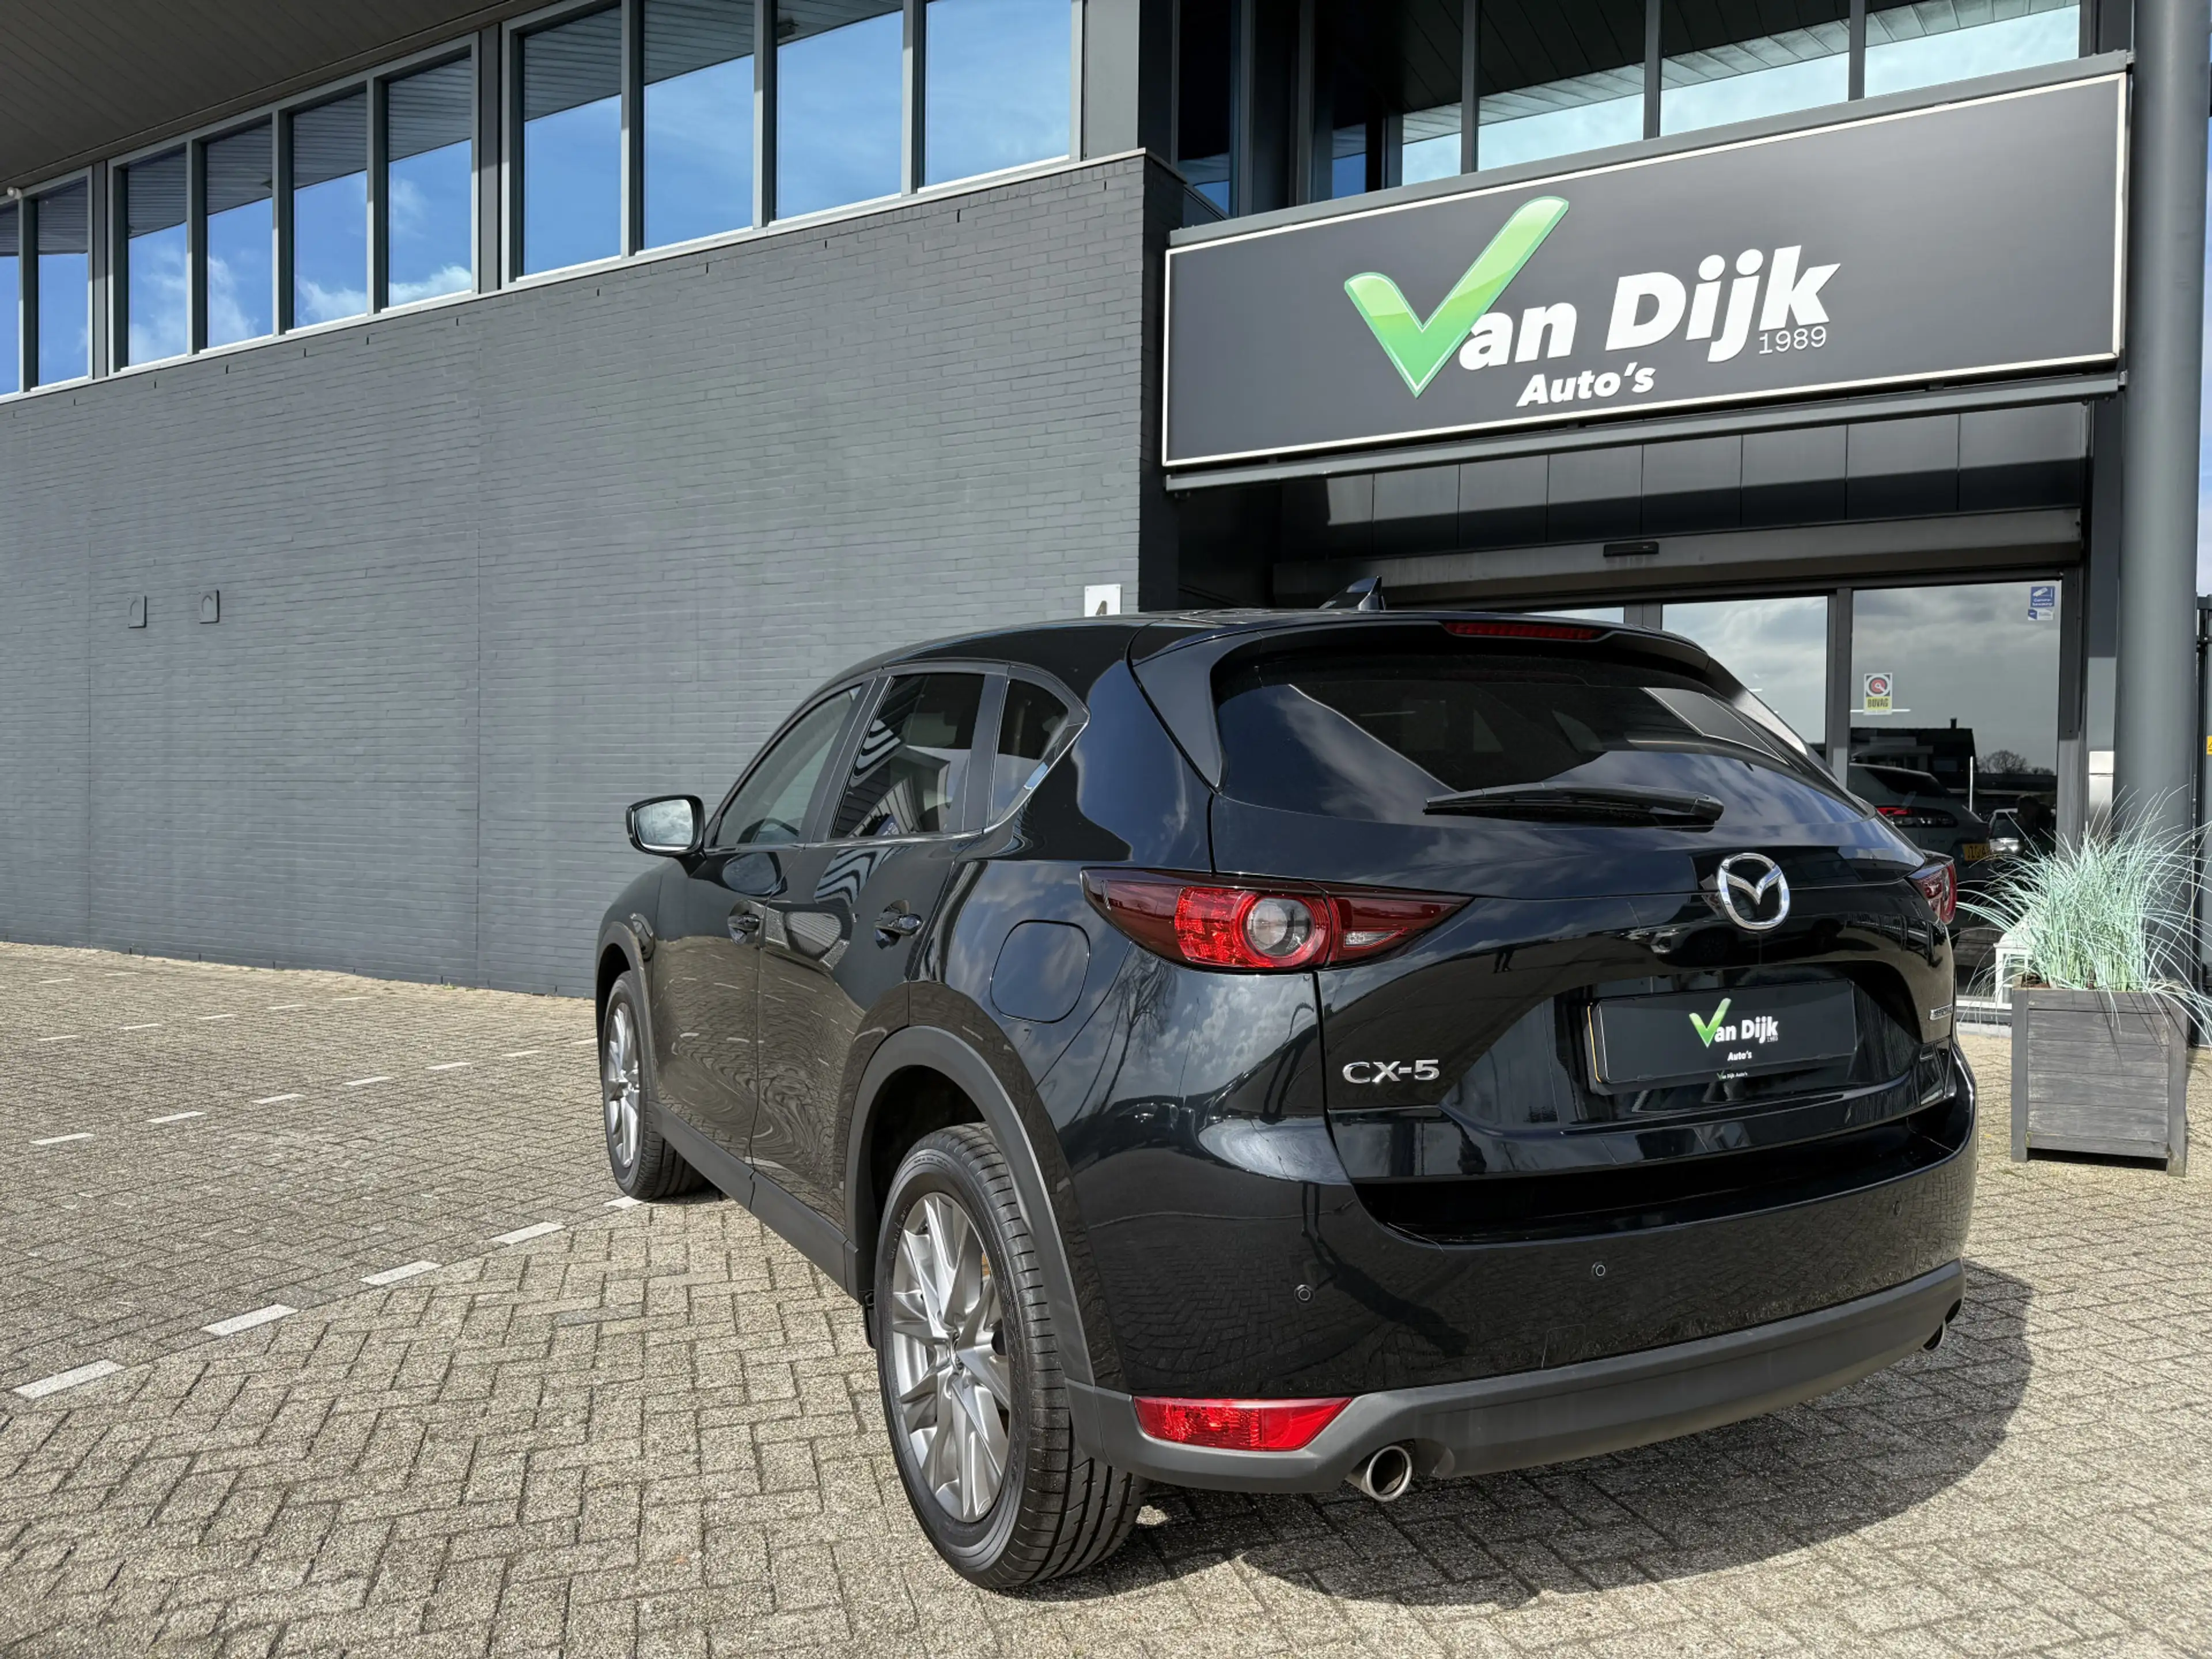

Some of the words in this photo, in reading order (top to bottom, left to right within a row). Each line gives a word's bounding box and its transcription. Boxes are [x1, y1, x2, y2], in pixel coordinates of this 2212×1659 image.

[1343, 195, 1577, 399] Van
[1605, 244, 1841, 363] Dijk
[1758, 325, 1827, 355] 1989
[1516, 362, 1656, 407] Auto's
[1688, 997, 1737, 1048] Van
[1741, 1016, 1779, 1044] Dijk
[1342, 1059, 1440, 1084] CX-5
[1727, 1050, 1752, 1062] Auto's
